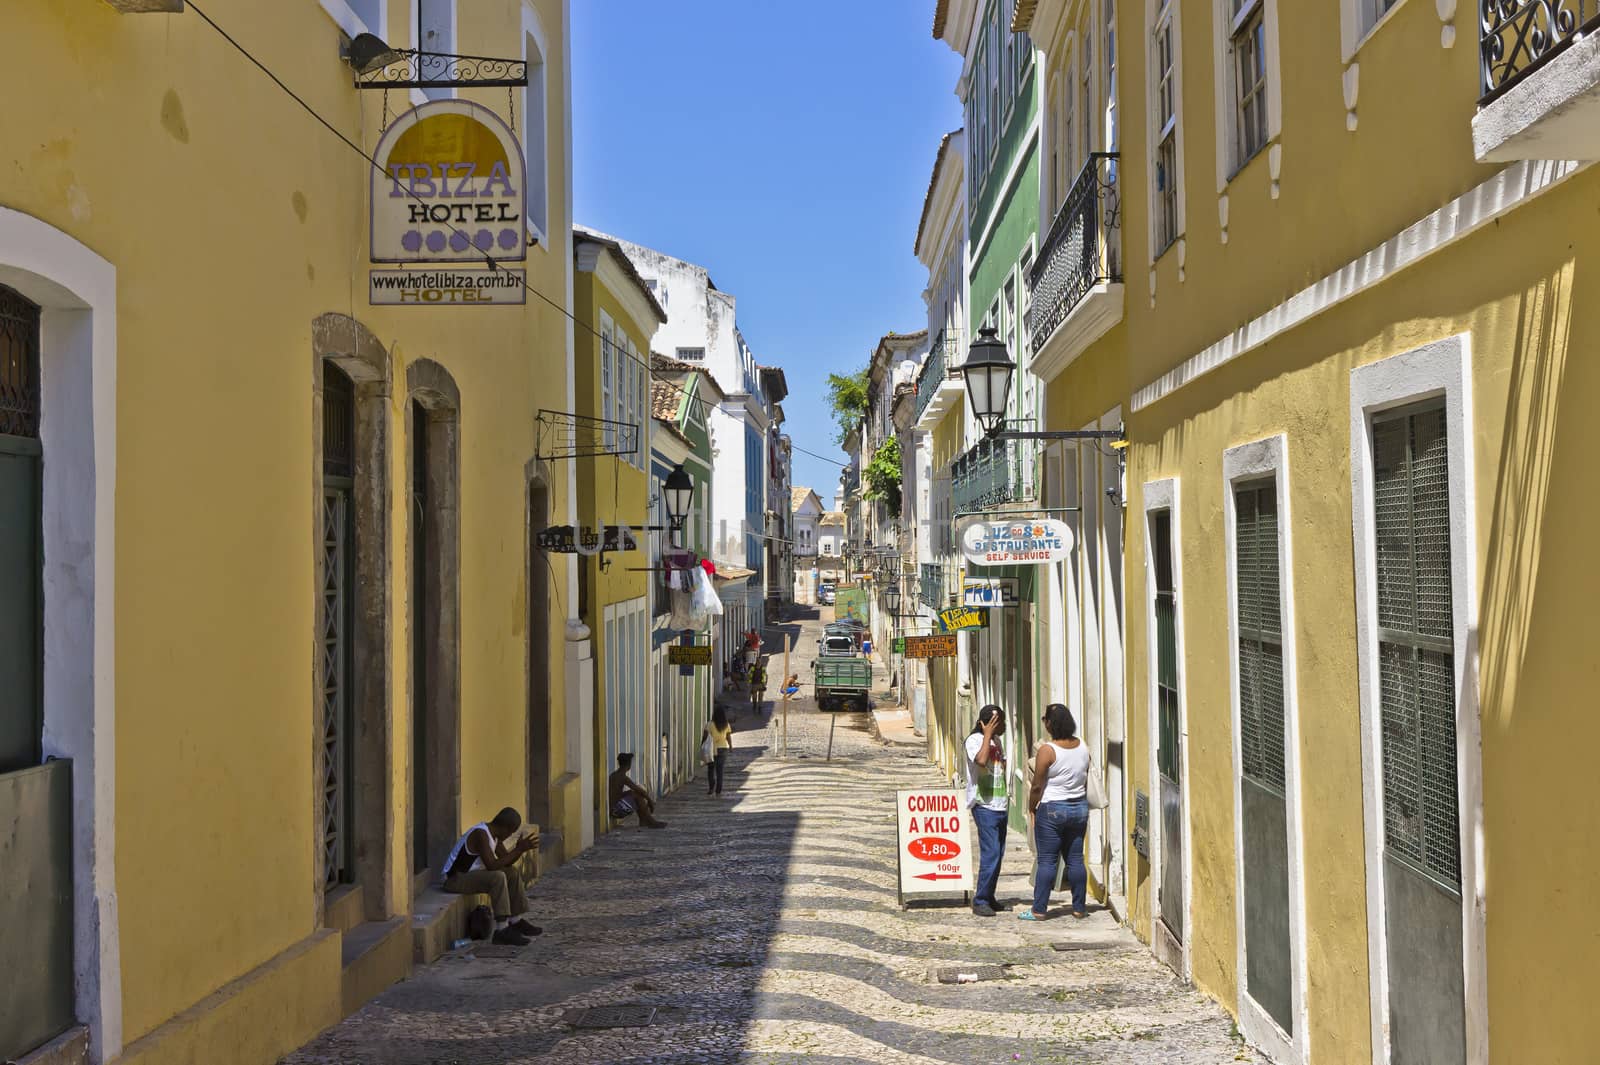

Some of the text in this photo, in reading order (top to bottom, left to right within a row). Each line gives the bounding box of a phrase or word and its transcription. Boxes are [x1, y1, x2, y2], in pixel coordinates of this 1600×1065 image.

[389, 161, 517, 198] IBIZA
[408, 203, 519, 223] HOTEL
[373, 272, 521, 289] www.hotelibiza.com.br
[400, 289, 493, 302] HOTEL
[975, 538, 1062, 553] RESTAURANTE
[986, 551, 1051, 562] SELF SERVICE
[908, 795, 958, 812] COMIDA
[909, 816, 960, 833] A KILO
[921, 844, 947, 856] 1,80
[937, 864, 960, 872] 100gr
